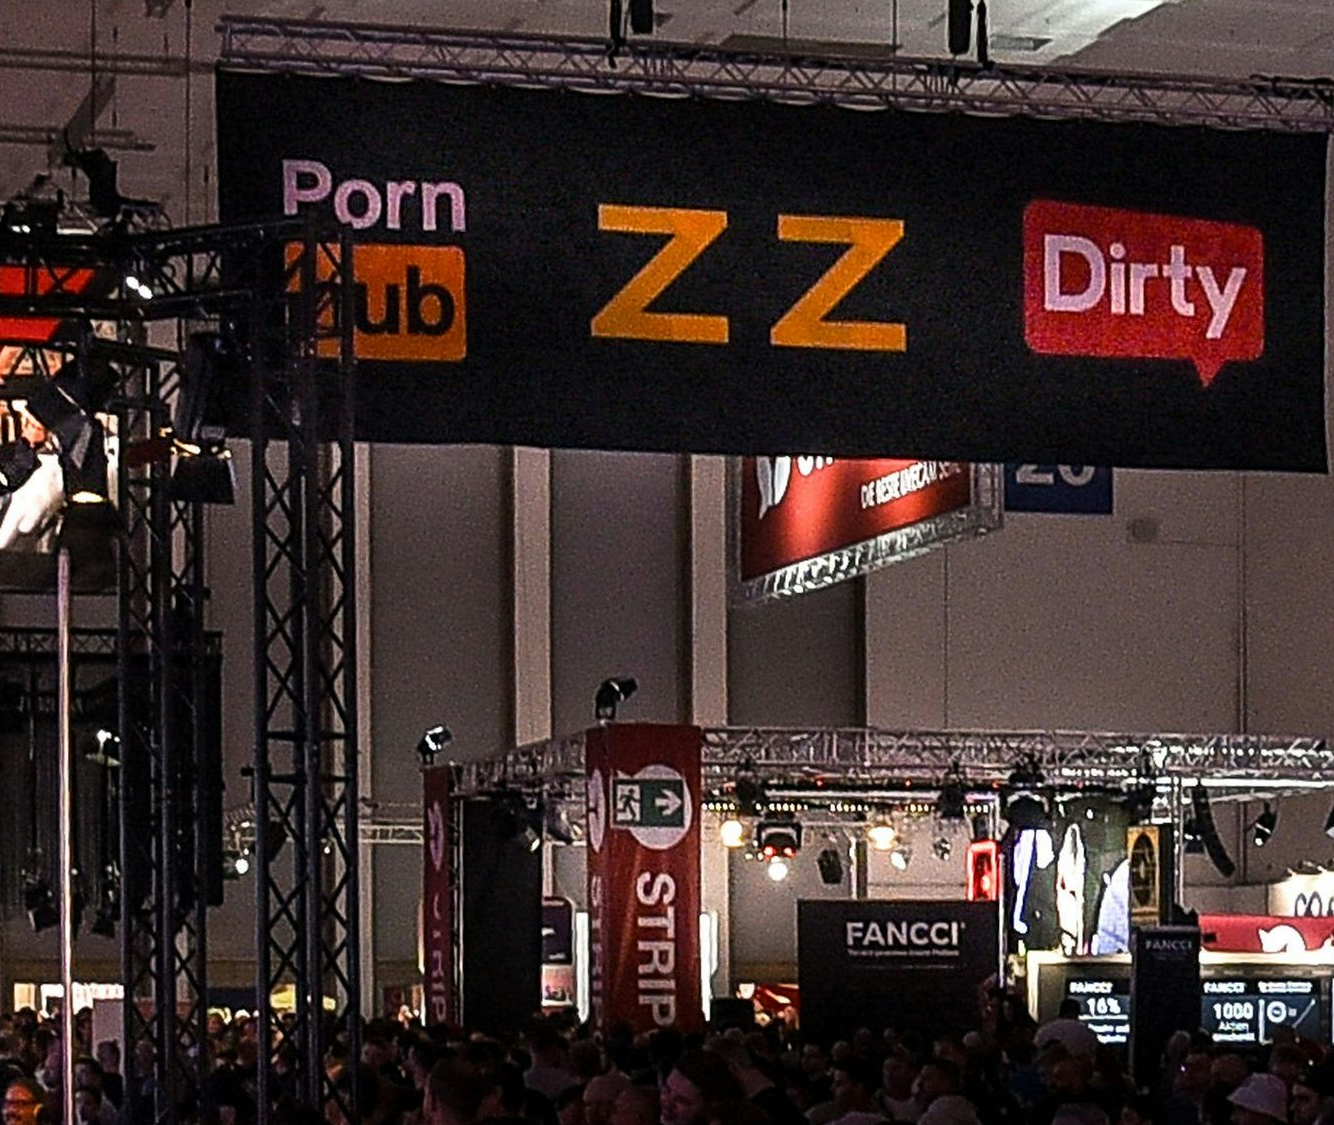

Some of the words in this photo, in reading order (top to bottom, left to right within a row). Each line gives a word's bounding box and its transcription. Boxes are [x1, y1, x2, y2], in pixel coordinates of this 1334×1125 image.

[282, 159, 466, 232] Porn
[1041, 234, 1246, 341] Dirty
[845, 921, 959, 946] FANCCI
